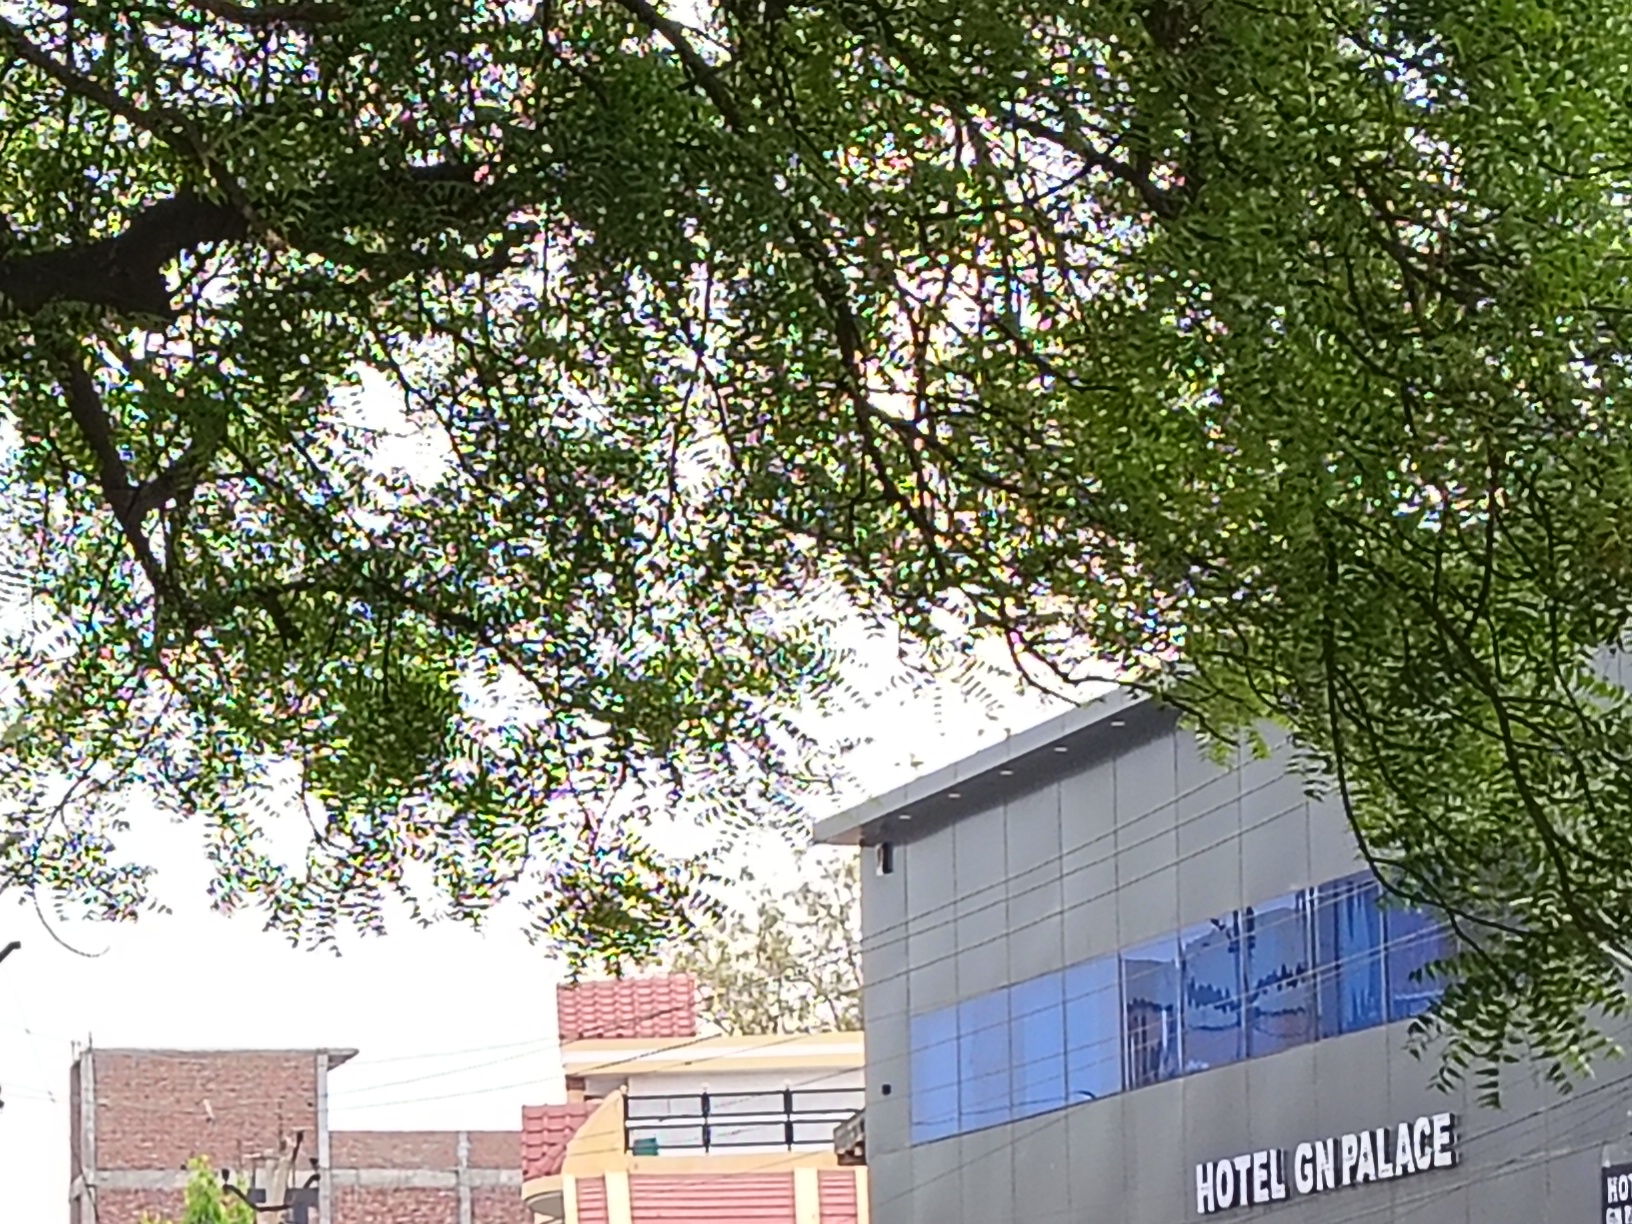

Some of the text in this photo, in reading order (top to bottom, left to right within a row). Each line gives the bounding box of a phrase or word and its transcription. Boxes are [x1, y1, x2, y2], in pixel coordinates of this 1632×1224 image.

[1196, 1112, 1455, 1214] HOTEL GN PALACE
